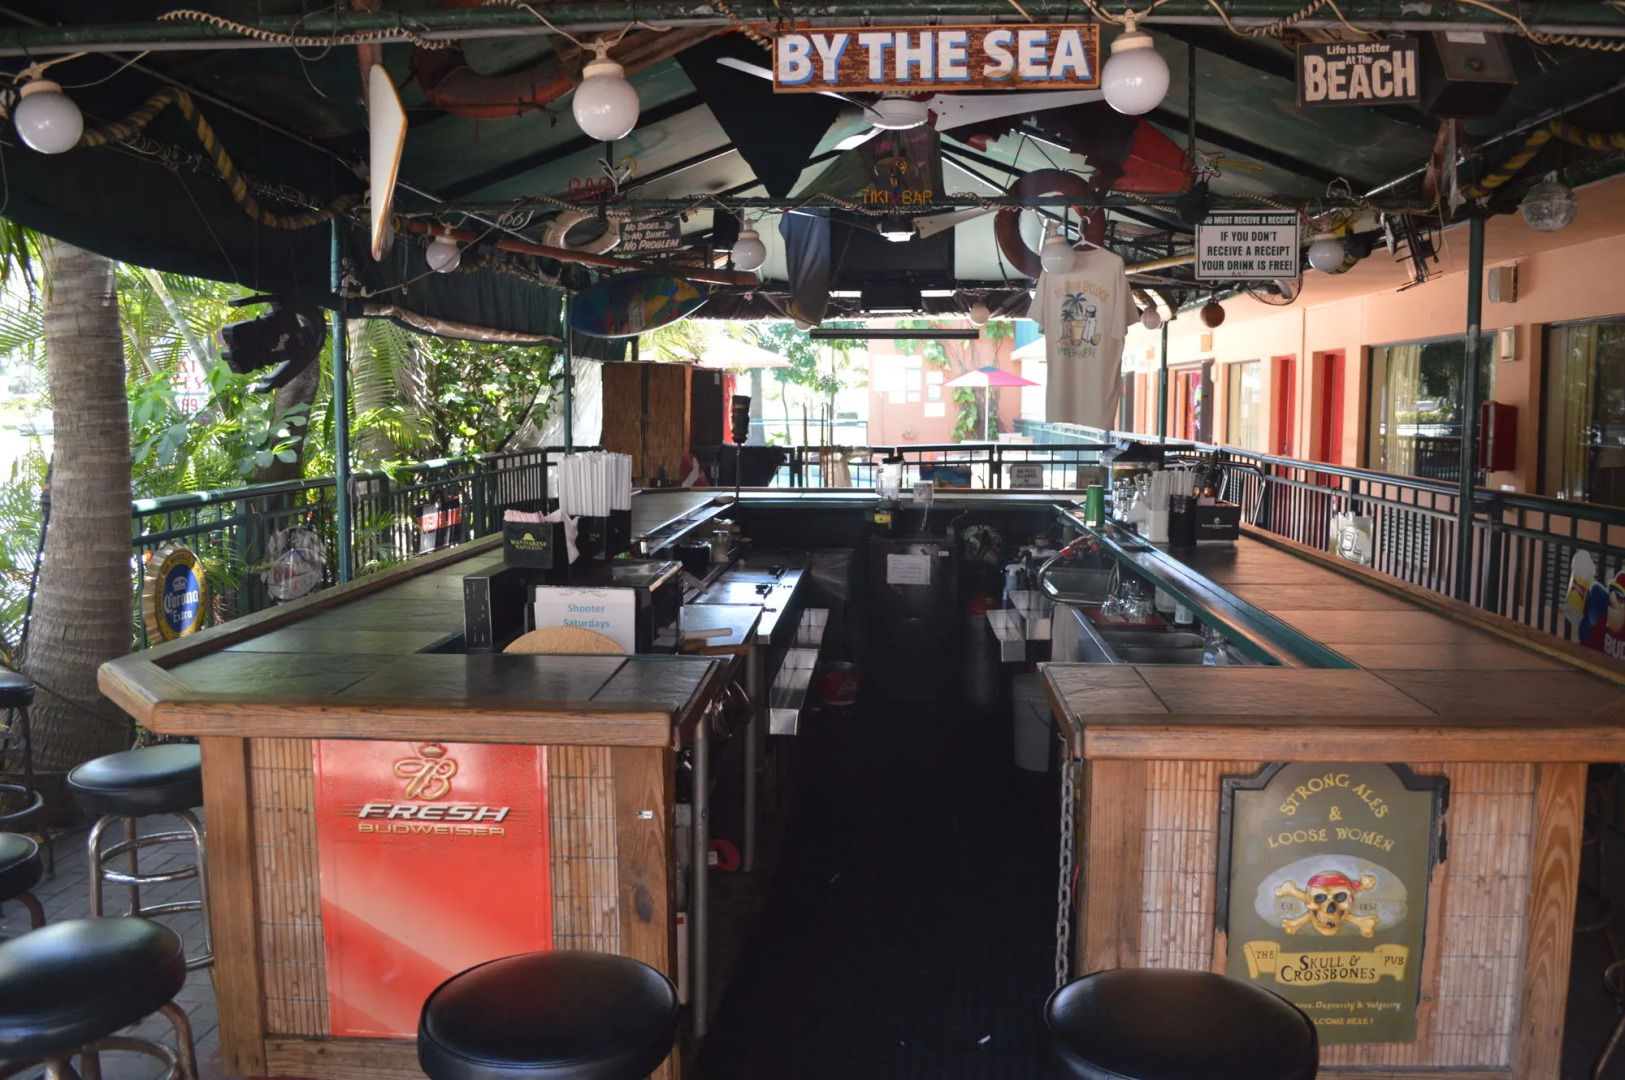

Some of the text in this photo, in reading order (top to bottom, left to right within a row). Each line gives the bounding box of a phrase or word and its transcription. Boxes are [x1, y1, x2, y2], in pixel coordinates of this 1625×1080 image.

[1326, 43, 1391, 55] Life Is Better
[778, 29, 1091, 85] BY THE SEA
[1346, 55, 1373, 65] At The
[1303, 50, 1416, 102] BEACH
[860, 188, 933, 205] TIKI BAR
[1214, 216, 1233, 224] MUST
[1234, 216, 1260, 224] RECEIVE
[1261, 216, 1267, 224] A
[624, 223, 636, 231] NO
[1220, 231, 1277, 241] IF YOU DON'T
[623, 239, 679, 251] NO PROBLEM
[1207, 246, 1290, 256] RECEIVE A RECEIPT
[1201, 260, 1293, 271] YOUR DRINK IS FREE!
[164, 590, 199, 614] Corona
[567, 603, 606, 613] Shooter
[173, 609, 193, 623] Extra
[563, 618, 610, 629] Saturdays
[1280, 773, 1389, 818] STRONG ALES
[358, 803, 511, 822] FRESH
[1329, 805, 1342, 821] &
[358, 823, 505, 837] BUDWEISER
[1267, 827, 1395, 852] LOOSE WOMEN
[1255, 950, 1275, 959] THE
[1384, 955, 1404, 967] PUB
[1300, 955, 1360, 971] SKULL &
[1281, 965, 1376, 982] CROSSBONES
